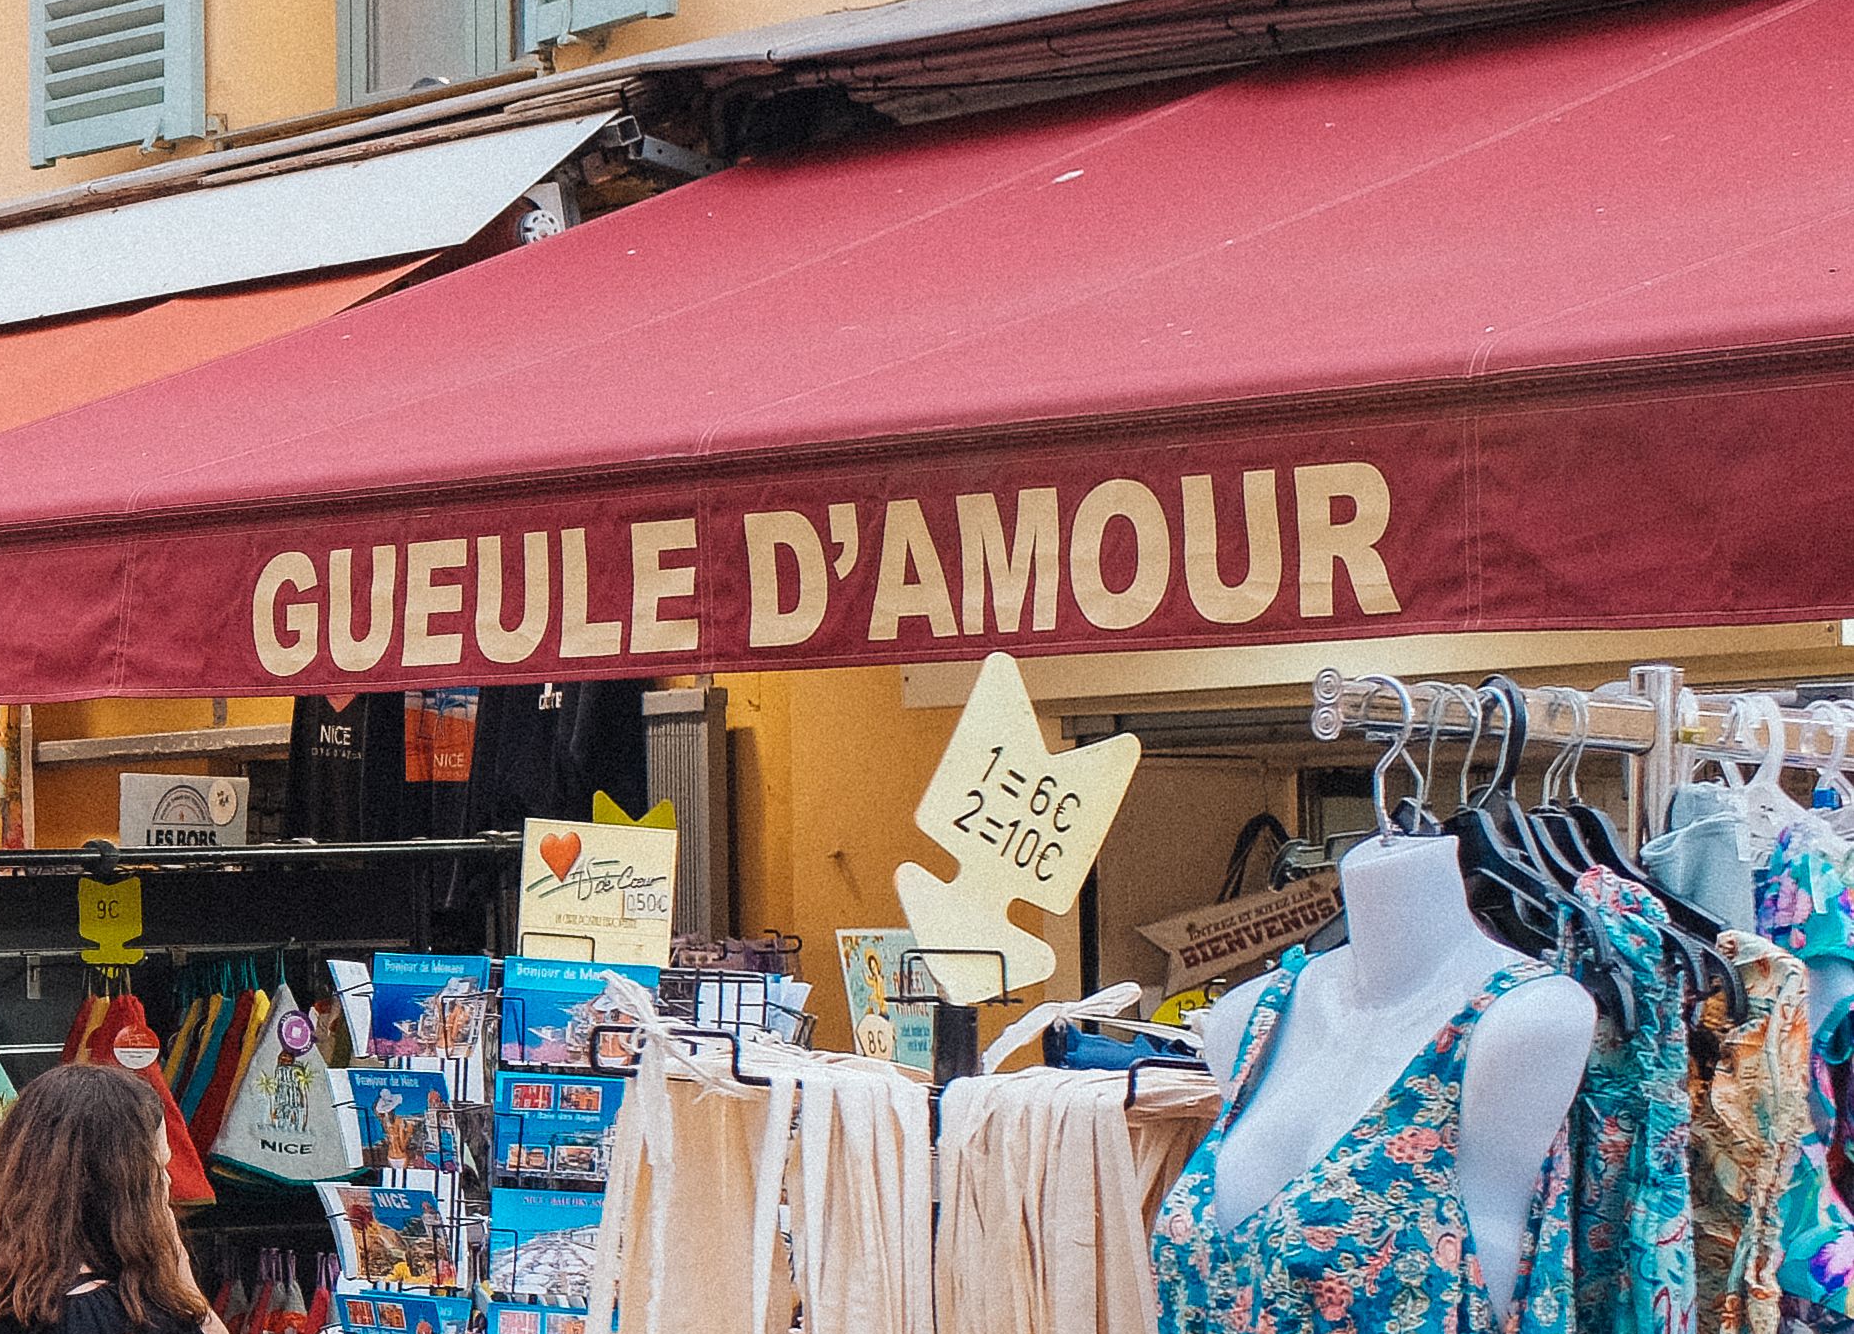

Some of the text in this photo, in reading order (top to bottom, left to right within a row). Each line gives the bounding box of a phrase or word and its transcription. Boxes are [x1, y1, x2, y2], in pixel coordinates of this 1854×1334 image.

[251, 462, 1403, 679] GUEULE D'AMOUR
[320, 723, 352, 746] NICE
[433, 752, 465, 768] NICE
[146, 828, 174, 846] LES
[96, 899, 120, 920] 9€
[384, 958, 418, 975] Bonjour
[515, 962, 577, 981] Bonjour de
[867, 1030, 887, 1054] 8€
[260, 1138, 313, 1155] NICE
[374, 1191, 412, 1210] NICE
